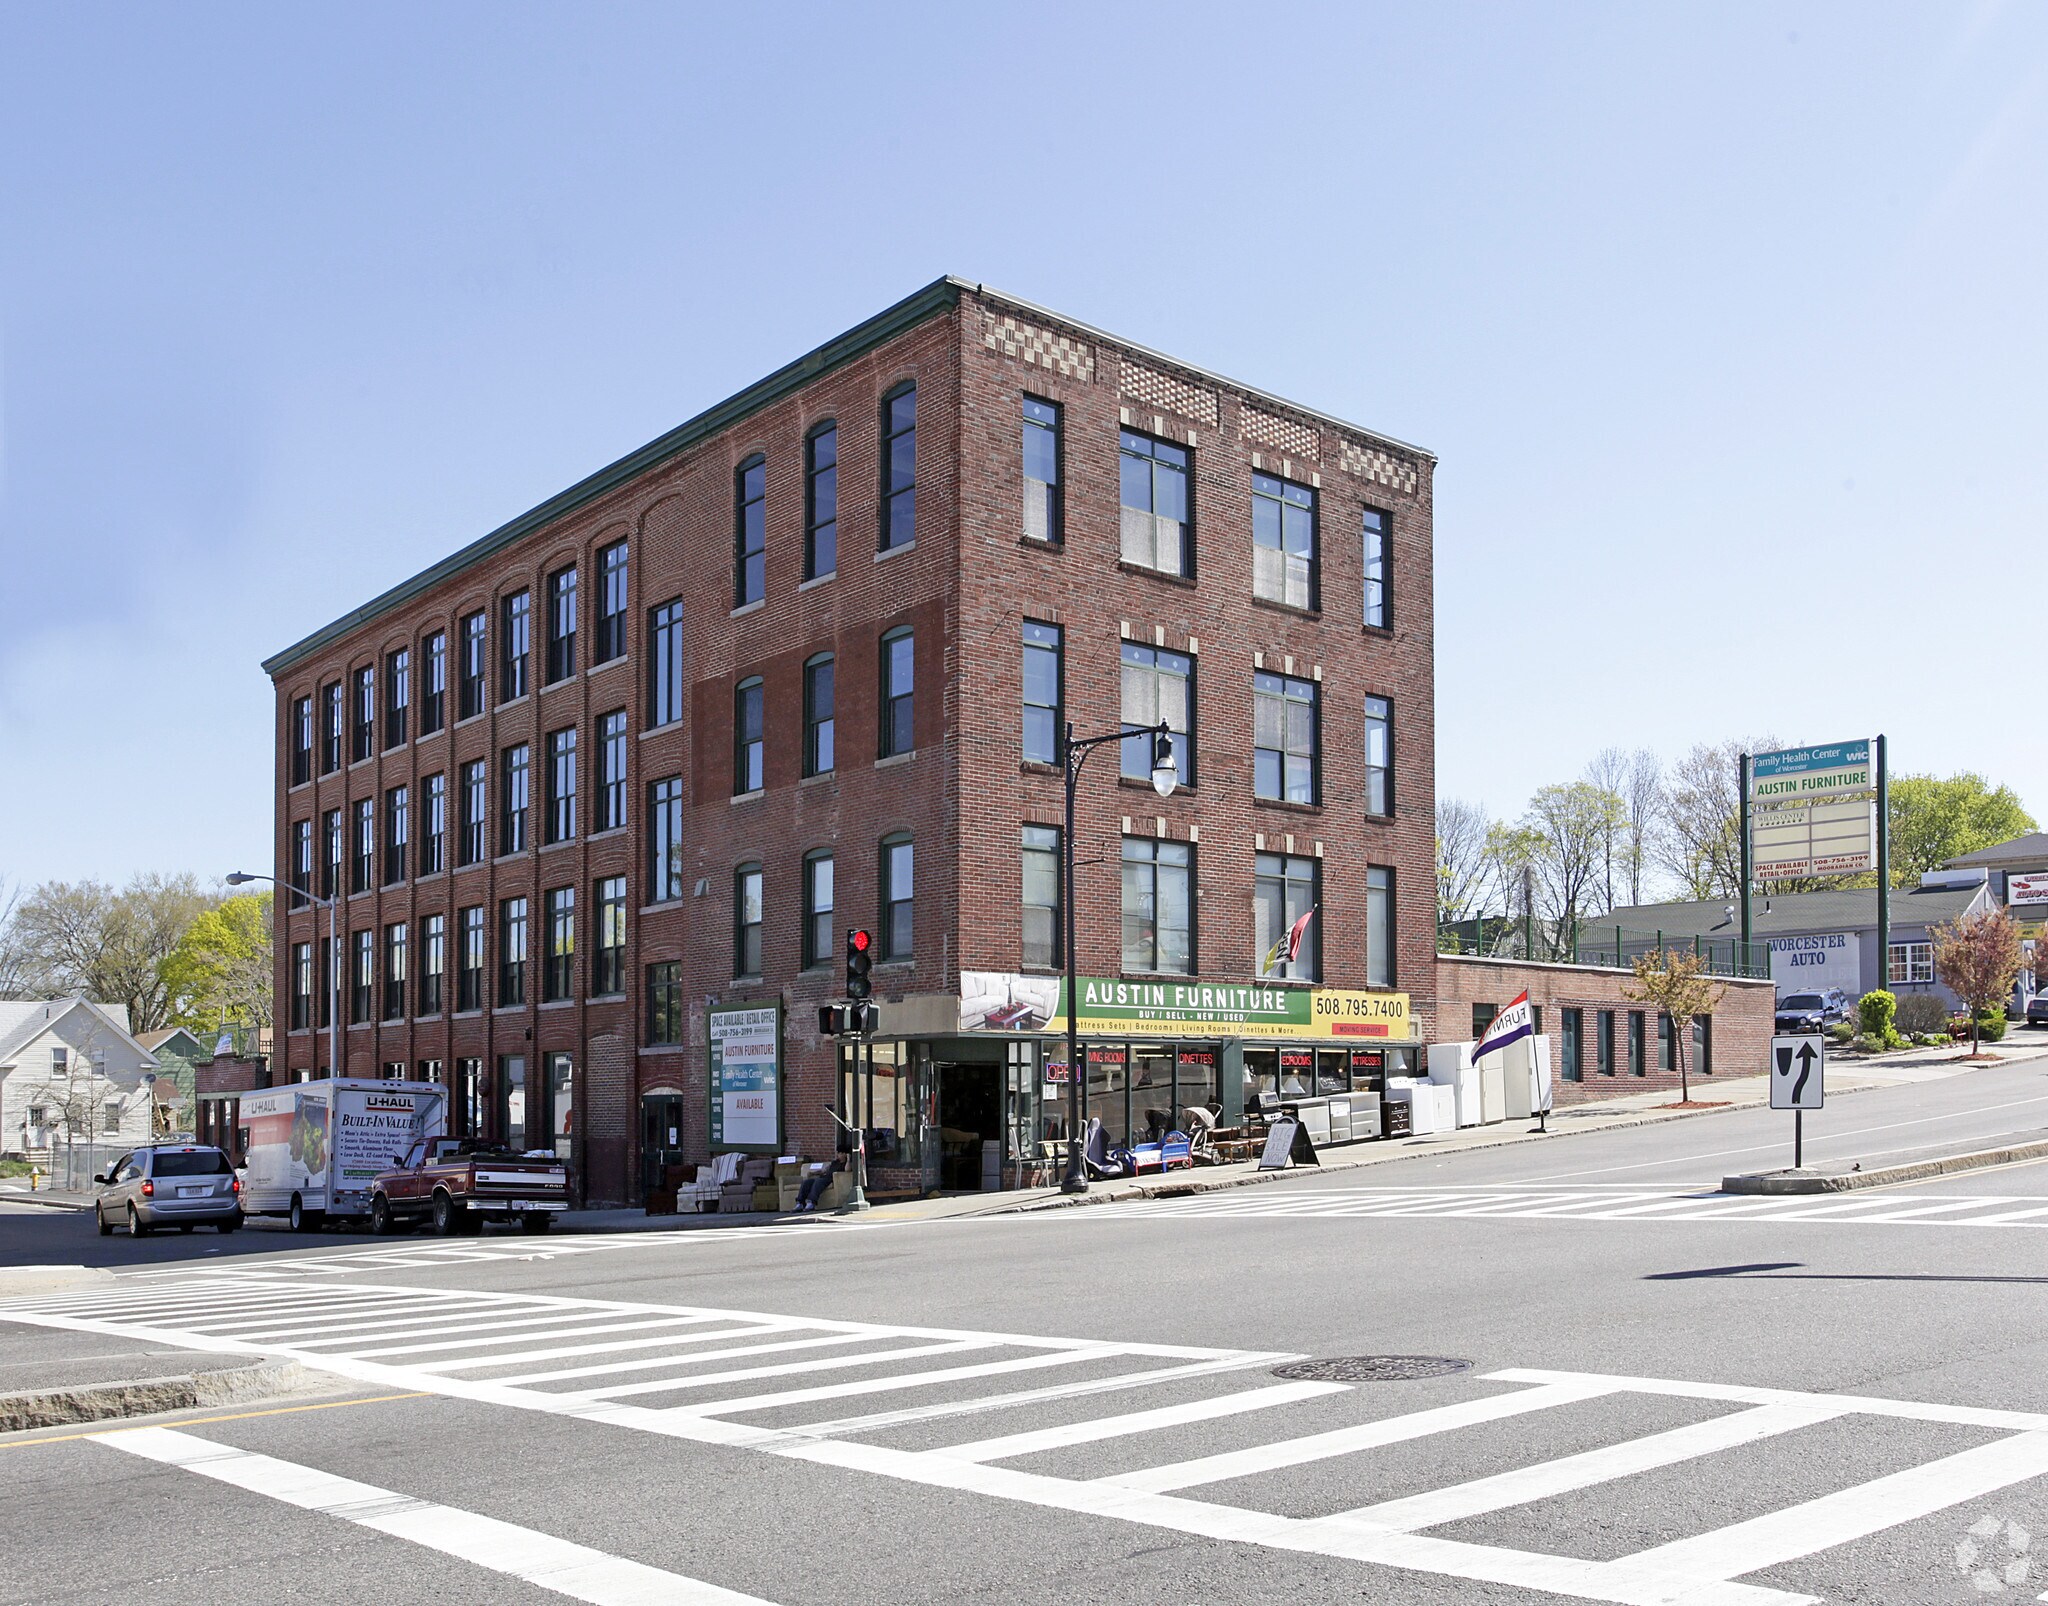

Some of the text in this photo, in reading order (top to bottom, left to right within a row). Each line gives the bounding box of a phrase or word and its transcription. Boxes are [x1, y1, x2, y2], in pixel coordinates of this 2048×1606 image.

[1754, 749, 1840, 768] Family Health Center
[1782, 764, 1807, 772] Worcester
[1757, 771, 1866, 795] AUSTIN FURNITURE
[1780, 812, 1805, 820] CENTER
[1814, 855, 1868, 865] 508-756-3199
[1755, 861, 1807, 871] SPACE AVAILABLE
[2015, 889, 2041, 899] AUTO
[1769, 934, 1846, 951] WORCESTER
[1790, 952, 1825, 966] AUTO
[1085, 982, 1286, 1010] AUSTIN FURNITURE
[1316, 997, 1403, 1018] 508.795.7400
[712, 1011, 775, 1027] SPACE AVAILABLE RETAIL OFFICE
[1139, 1010, 1155, 1019] BUY
[1165, 1011, 1186, 1020] SELL
[1197, 1012, 1213, 1020] NEW
[1224, 1013, 1244, 1022] USED
[719, 1028, 752, 1037] 508-756-3199
[1076, 1021, 1105, 1029] attress
[1109, 1022, 1126, 1030] Sets
[1136, 1023, 1173, 1031] Bedrooms
[1182, 1023, 1205, 1032] Living
[1207, 1024, 1231, 1032] Rooms
[1239, 1025, 1268, 1033] Dinettes
[1360, 1026, 1381, 1034] SERVICE
[725, 1046, 743, 1057] AUSTIN
[745, 1044, 774, 1056] FURNITURE
[1178, 1053, 1214, 1064] DINETTES
[1281, 1055, 1312, 1066] EDROOMS
[1352, 1056, 1382, 1066] ATTRESSES
[367, 1097, 414, 1108] U-HAUL
[736, 1098, 763, 1109] AVAILABLE
[1272, 1127, 1292, 1141] BIG
[1266, 1141, 1288, 1151] SALE
[1265, 1152, 1286, 1163] NOW
